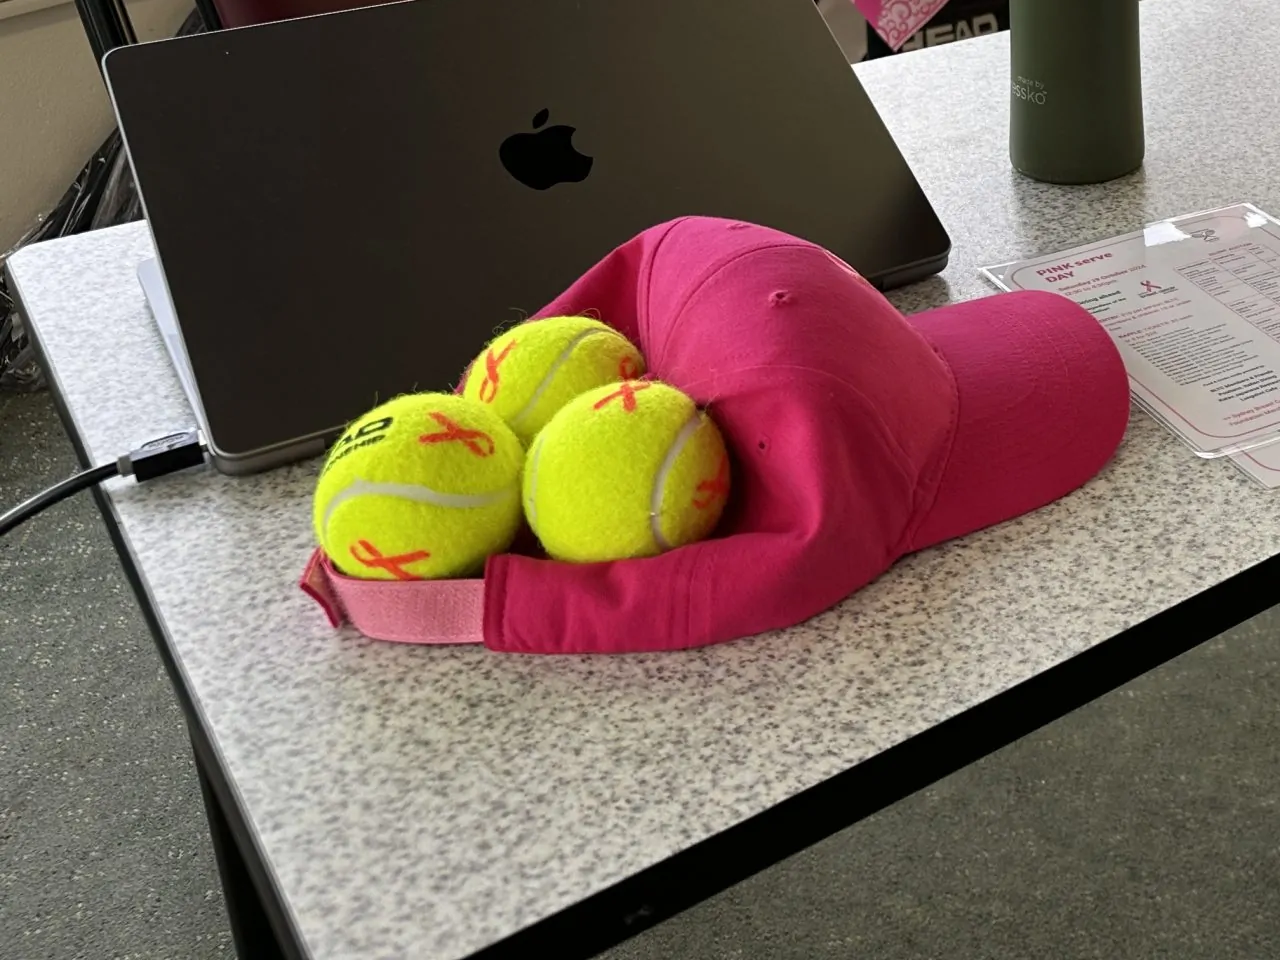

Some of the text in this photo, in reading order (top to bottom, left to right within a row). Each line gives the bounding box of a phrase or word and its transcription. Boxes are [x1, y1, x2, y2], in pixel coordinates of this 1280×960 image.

[1036, 253, 1112, 276] PINK serve
[1045, 271, 1074, 283] DAY
[1100, 270, 1128, 280] October
[1232, 409, 1255, 418] Sydney
[1254, 402, 1274, 411] Breast
[1229, 413, 1264, 426] Foundation
